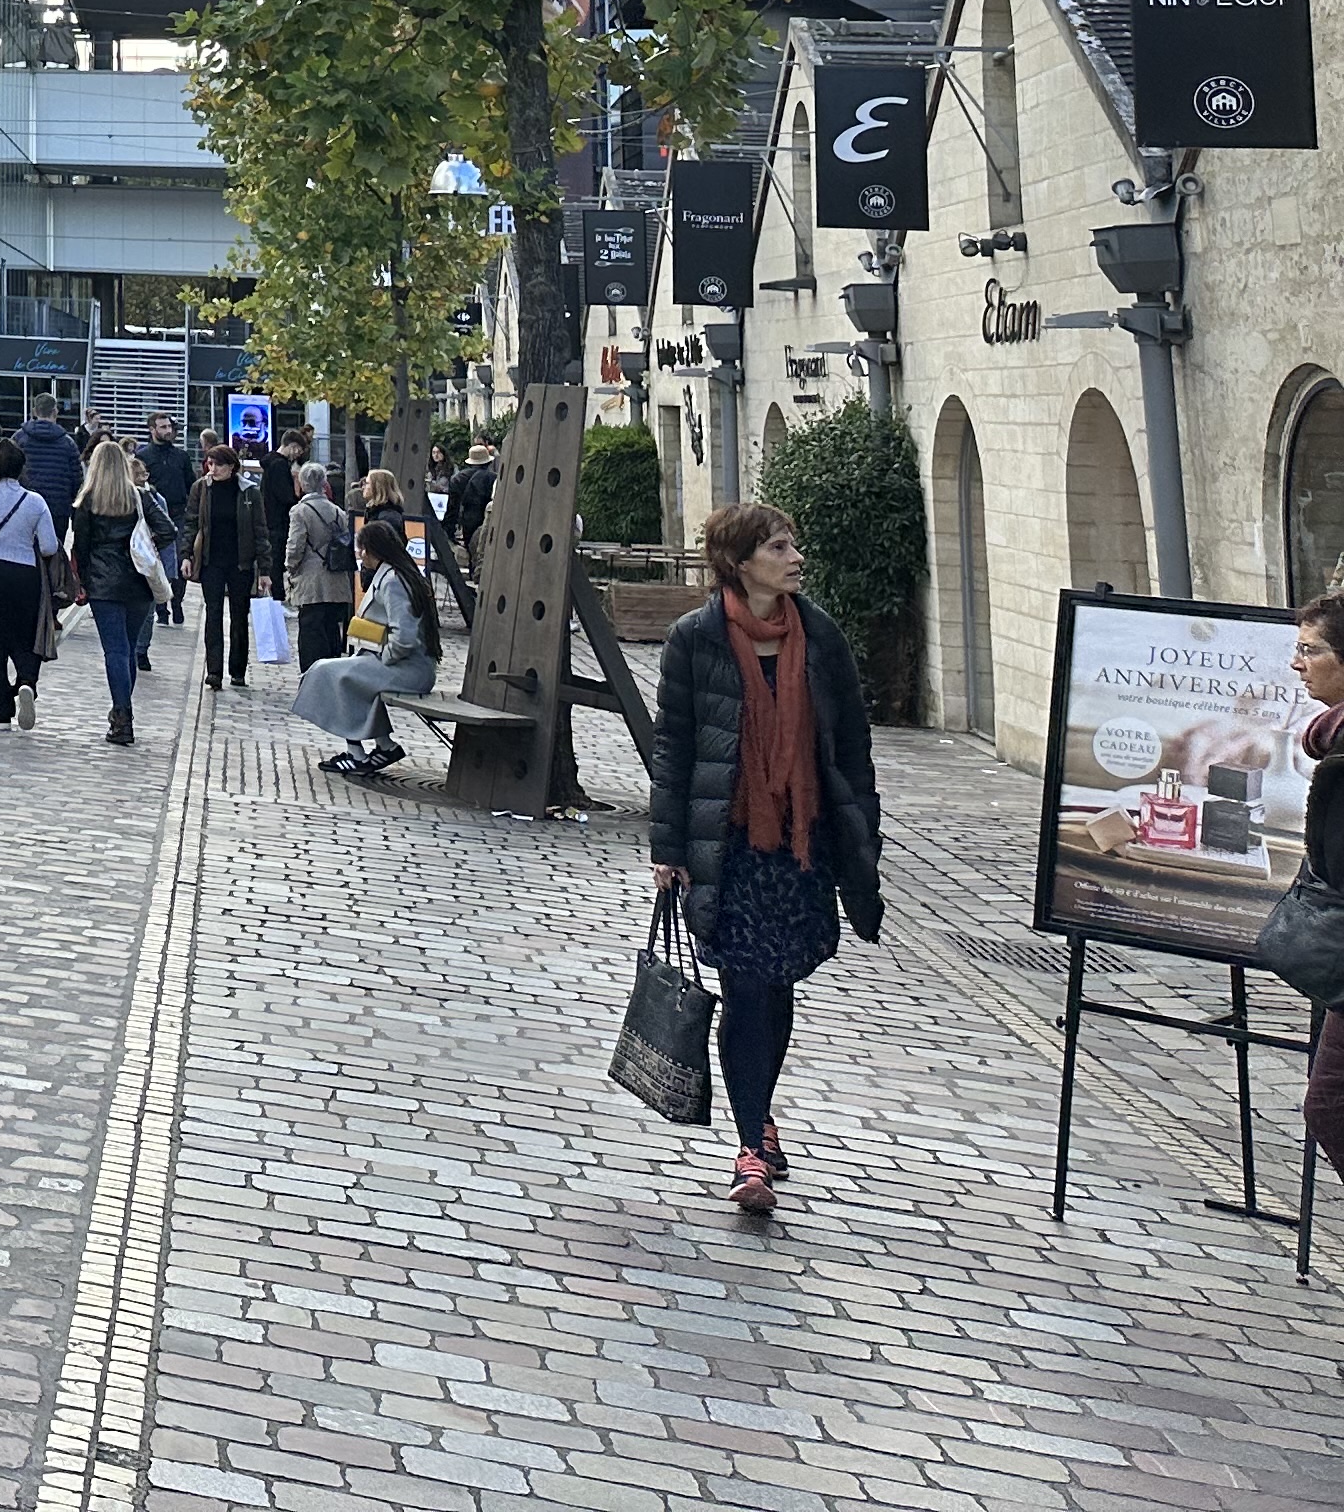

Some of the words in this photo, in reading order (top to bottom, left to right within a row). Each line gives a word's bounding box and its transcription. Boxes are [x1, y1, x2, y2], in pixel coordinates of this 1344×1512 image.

[1203, 79, 1244, 93] BERCY
[1202, 109, 1249, 126] VILLAGE
[682, 210, 744, 224] Fragonard
[599, 249, 609, 260] 2
[982, 278, 1041, 345] Etam
[1146, 645, 1257, 673] JOYEUX
[1094, 666, 1308, 705] ANNIVERSAIRE
[1117, 693, 1144, 704] votre
[1146, 695, 1191, 710] boutique
[1193, 701, 1231, 714] célèbre
[1253, 707, 1261, 717] 5
[1262, 709, 1281, 719] ans
[1105, 727, 1153, 742] VOTRE
[1099, 739, 1156, 755] CADEAU
